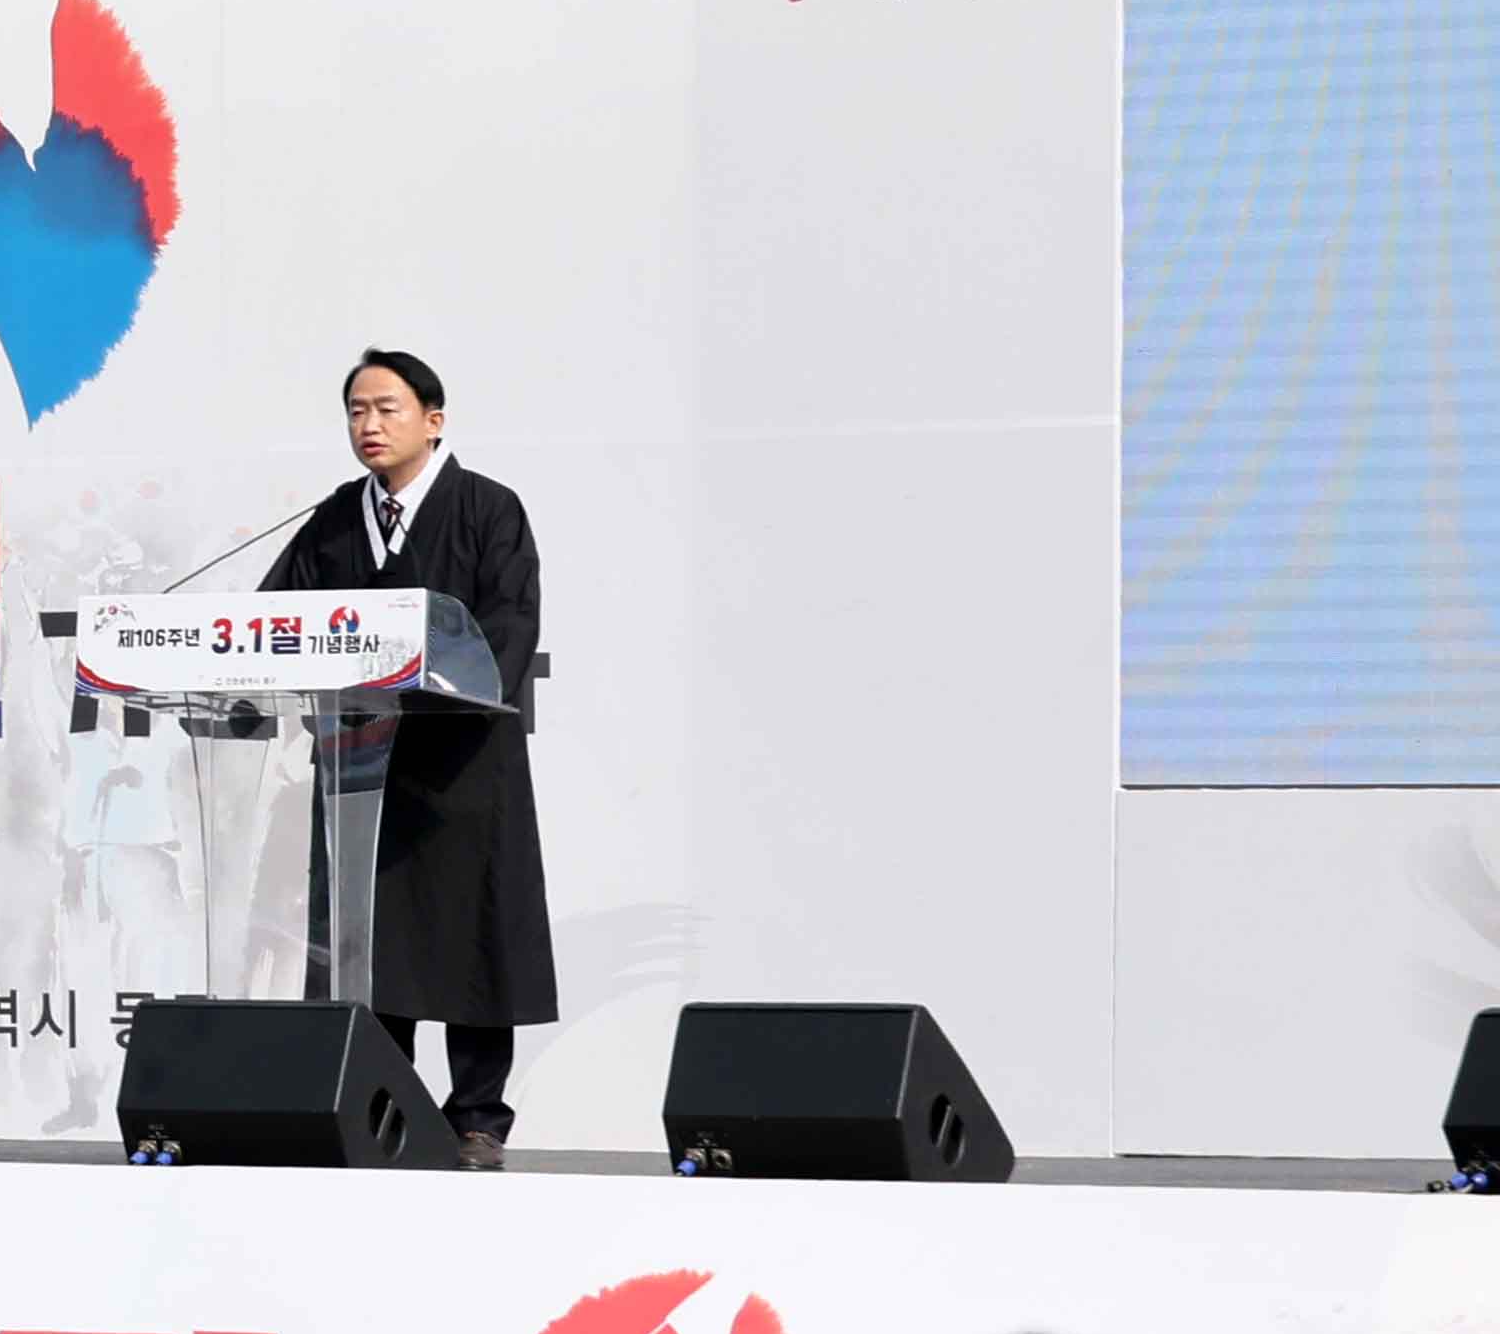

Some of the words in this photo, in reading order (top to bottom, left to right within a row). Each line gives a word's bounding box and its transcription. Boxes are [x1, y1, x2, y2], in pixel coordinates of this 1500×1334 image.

[117, 627, 201, 649] 제106주년
[210, 615, 301, 656] 3.1절
[308, 632, 381, 656] 기념행사
